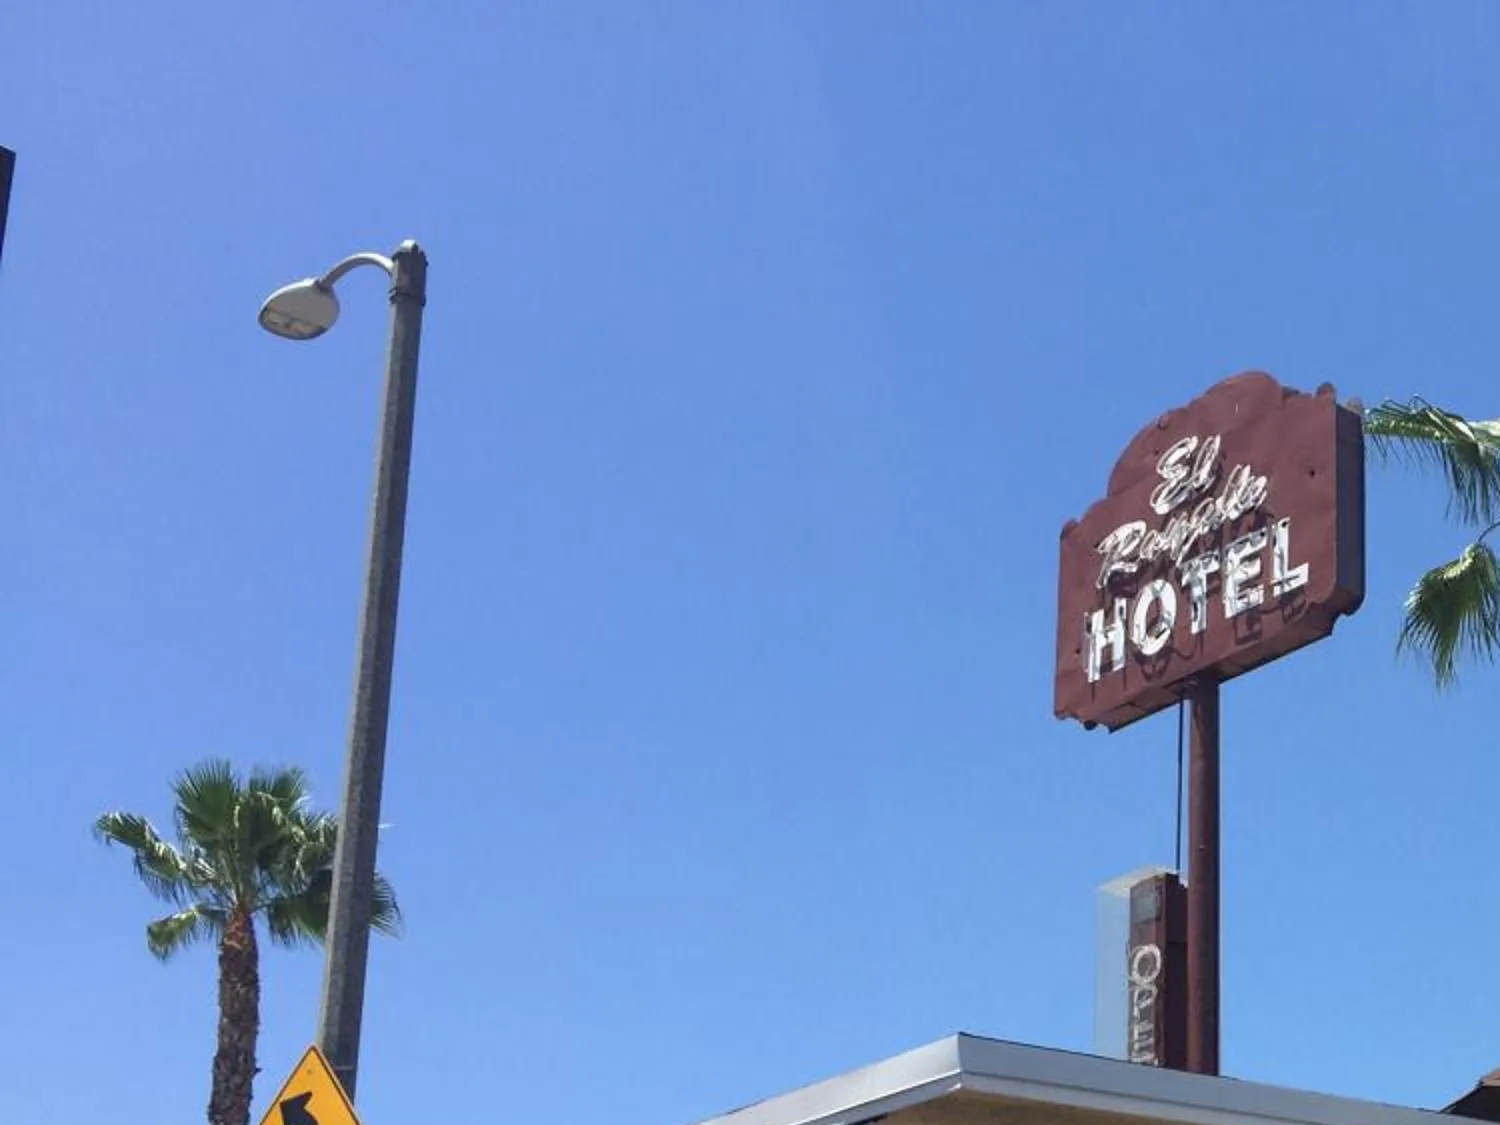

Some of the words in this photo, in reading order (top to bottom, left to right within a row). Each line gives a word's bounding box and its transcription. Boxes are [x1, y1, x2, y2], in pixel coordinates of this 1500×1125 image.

[1150, 434, 1221, 515] El
[1084, 516, 1309, 683] HOTEL
[1130, 943, 1162, 1067] OPE
